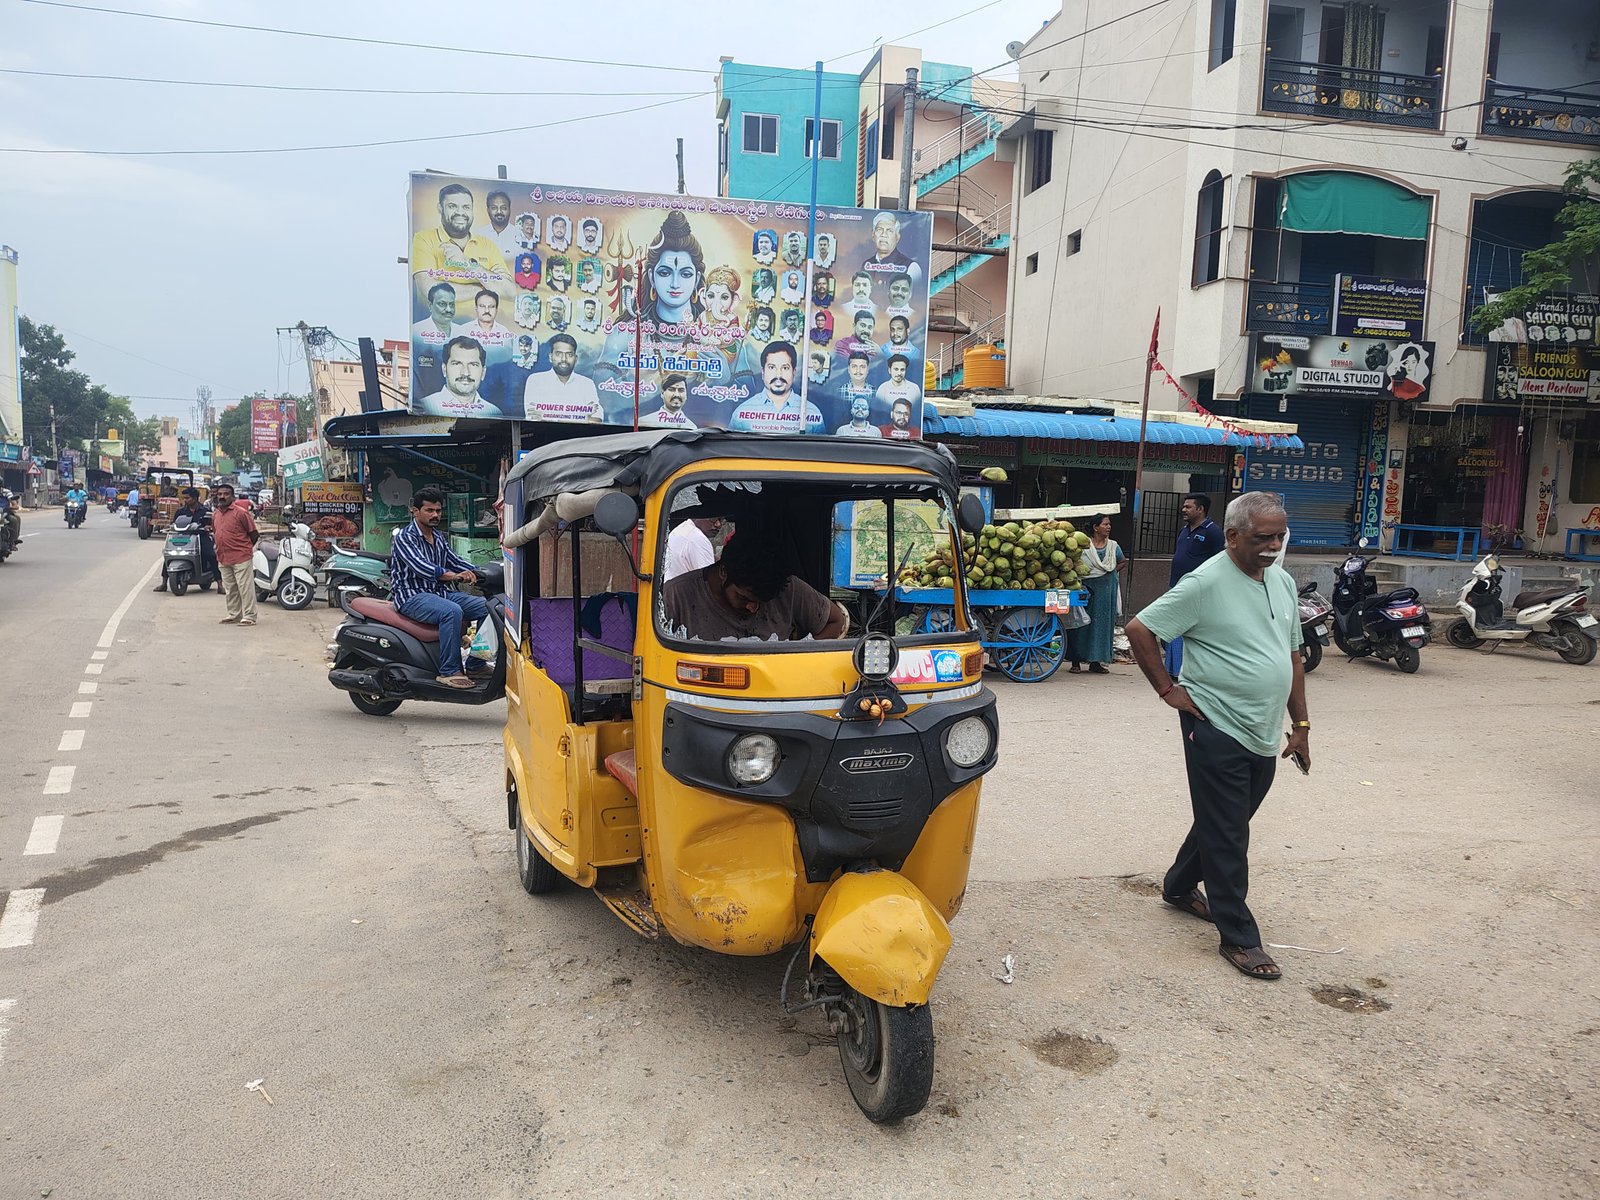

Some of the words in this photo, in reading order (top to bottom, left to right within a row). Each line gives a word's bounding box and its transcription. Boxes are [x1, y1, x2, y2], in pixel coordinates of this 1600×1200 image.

[530, 186, 542, 203] శ్రీ
[546, 190, 583, 203] అభయ
[585, 192, 635, 207] వినాయక
[602, 316, 614, 334] శ్రీ
[1526, 311, 1569, 325] SALOON
[1571, 314, 1594, 327] GUY
[1534, 352, 1577, 365] FRIENDS
[663, 356, 722, 377] శివరాత్రి
[1520, 366, 1564, 378] SALOON
[1566, 368, 1590, 379] GUY
[1302, 370, 1340, 382] DIGITAL
[1343, 373, 1381, 385] STUDIO
[1521, 380, 1544, 393] Mens
[1547, 382, 1585, 394] Parlour
[536, 402, 564, 412] POWER
[565, 404, 593, 413] SUMAN
[657, 411, 687, 424] Prabhu
[739, 411, 775, 420] RECHETI
[294, 445, 320, 460] SBM
[1027, 437, 1091, 456] QUALITY
[1096, 440, 1165, 460] CHICEN
[1167, 445, 1225, 463] CENTER
[1076, 457, 1099, 467] Chicken
[1100, 459, 1131, 469] Wholesale
[1457, 458, 1488, 466] SALOON
[1488, 460, 1505, 468] GUY
[1249, 463, 1343, 483] STUDIO
[1354, 455, 1366, 523] STUDIO
[1370, 477, 1381, 490] &
[307, 491, 324, 502] Red
[864, 747, 893, 755] BAJAJ
